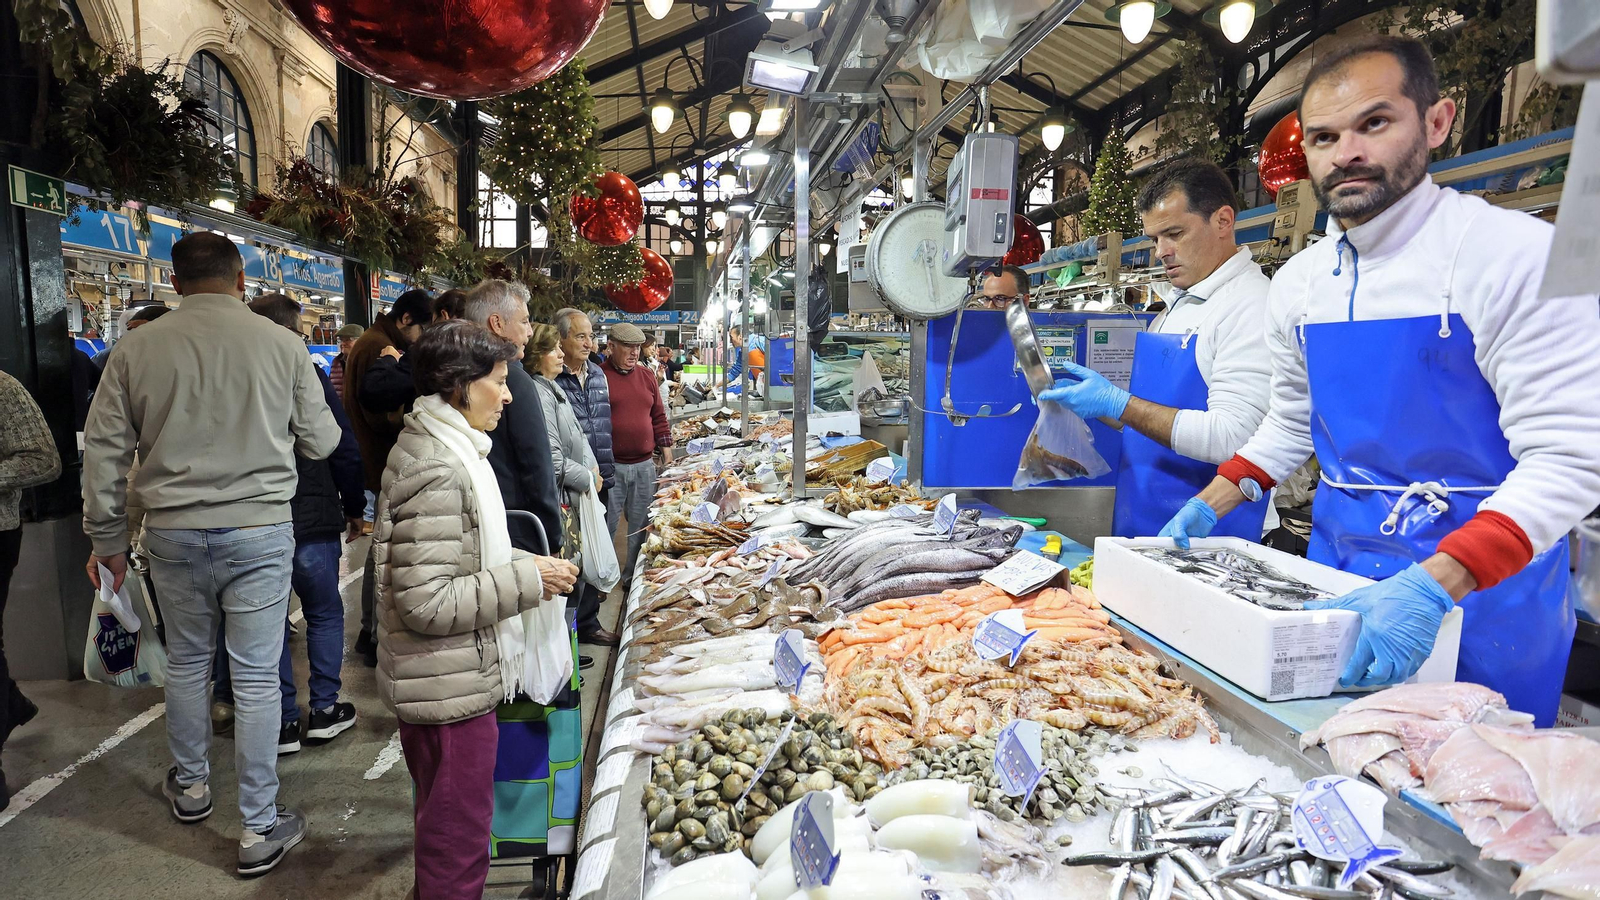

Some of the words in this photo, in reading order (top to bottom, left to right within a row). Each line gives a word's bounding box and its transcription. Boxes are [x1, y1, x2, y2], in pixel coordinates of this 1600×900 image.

[100, 213, 132, 251] 17
[260, 249, 279, 280] 18
[682, 311, 699, 324] 24
